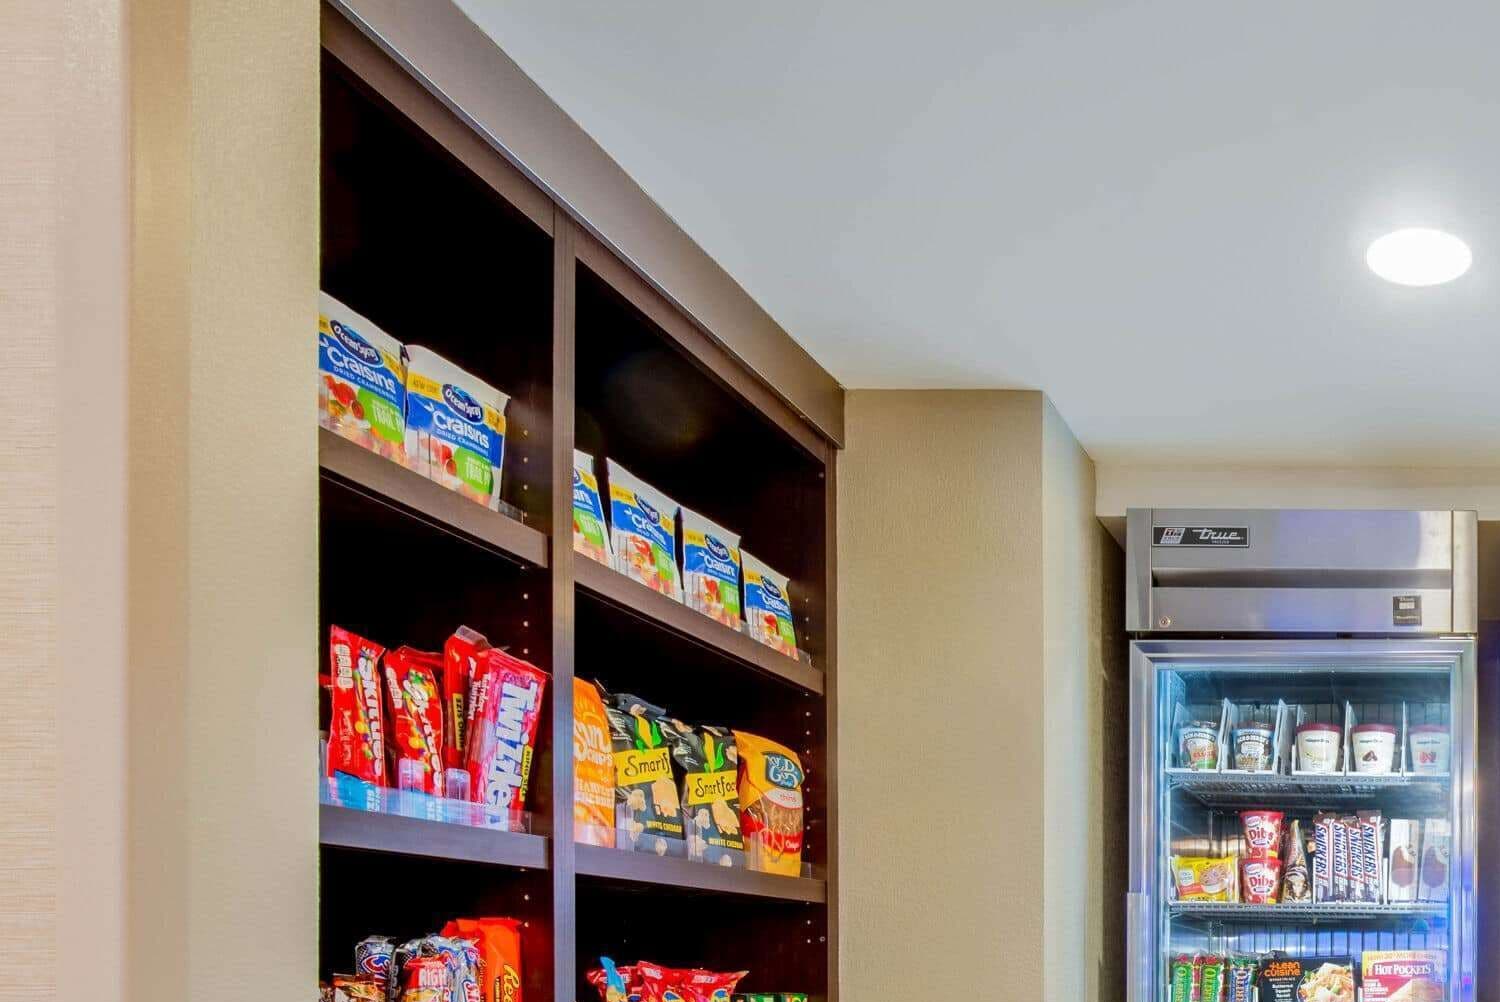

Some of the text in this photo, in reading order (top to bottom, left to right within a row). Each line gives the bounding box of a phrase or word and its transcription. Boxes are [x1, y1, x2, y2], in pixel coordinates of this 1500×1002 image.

[327, 345, 397, 395] Craisins
[432, 410, 489, 449] Craisins
[1315, 824, 1328, 878] SNICKERS
[1350, 828, 1361, 881] SNICKERS
[1364, 825, 1377, 878] SNICKERS
[1374, 964, 1431, 975] HOT POCKETS
